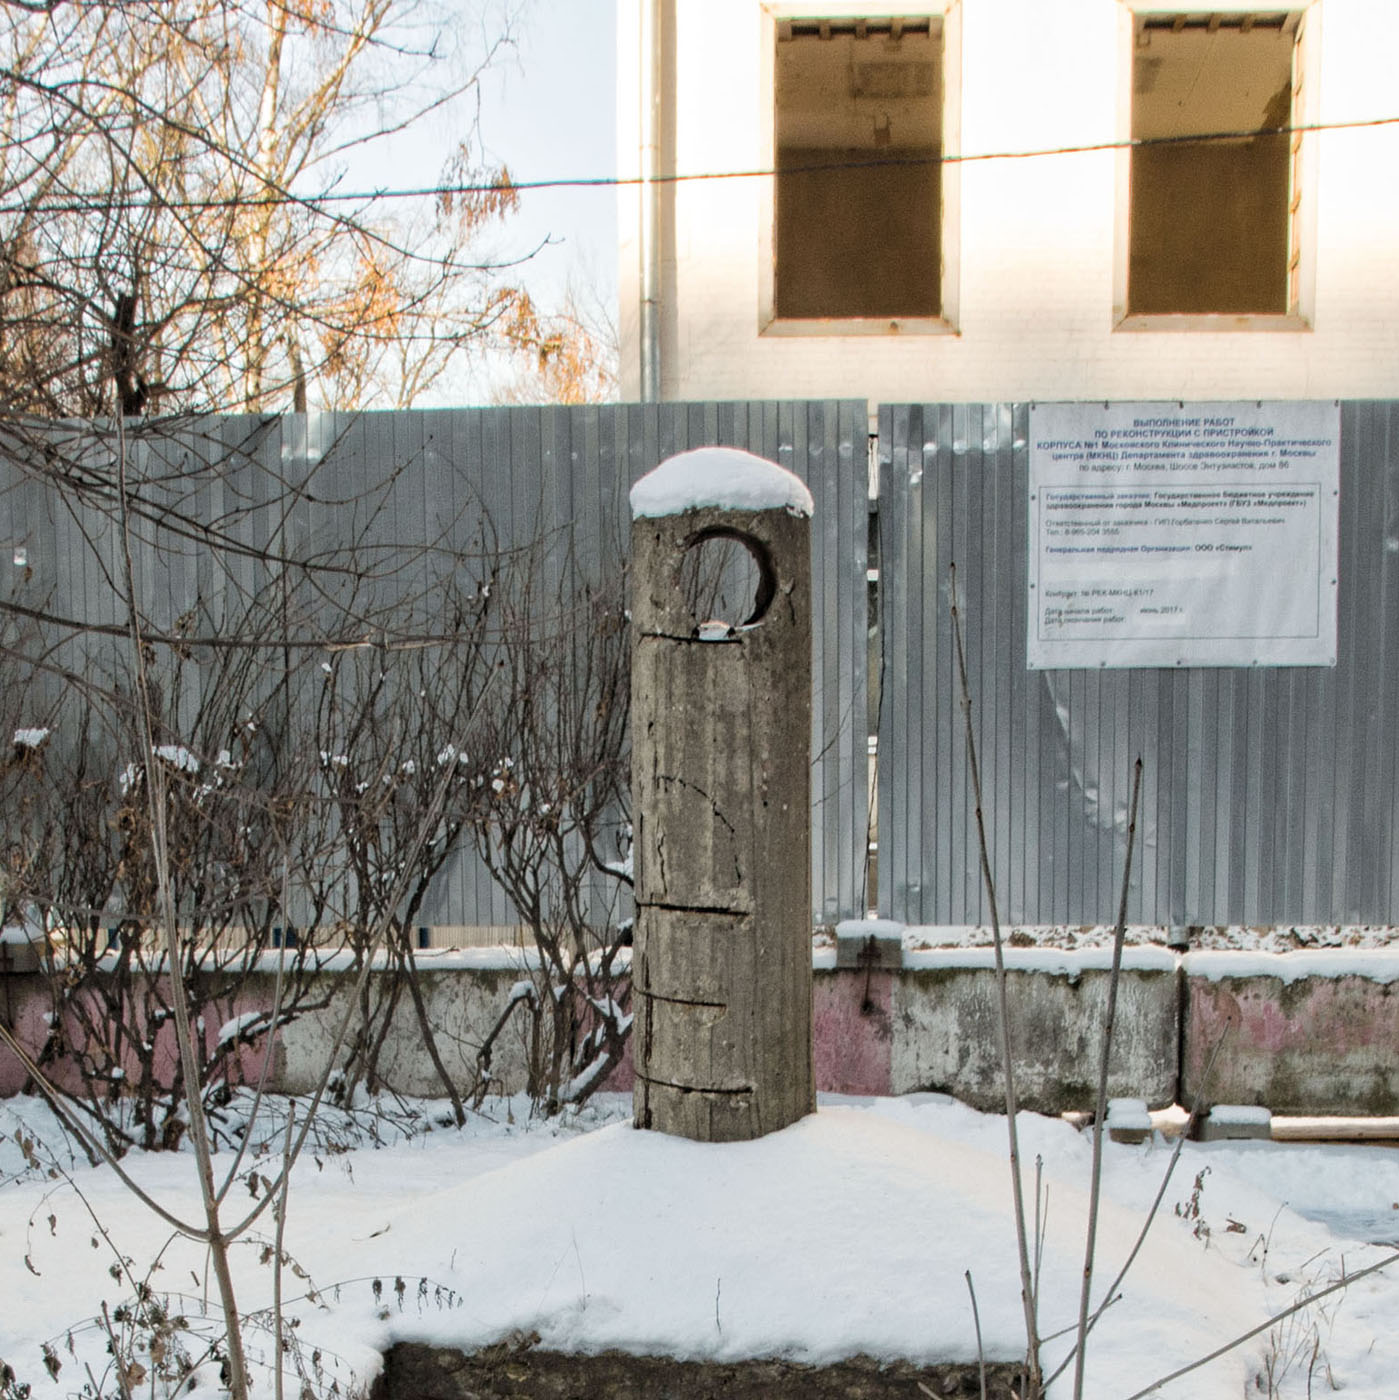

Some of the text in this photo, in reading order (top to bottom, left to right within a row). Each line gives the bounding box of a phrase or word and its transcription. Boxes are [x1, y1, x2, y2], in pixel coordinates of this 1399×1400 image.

[1133, 418, 1236, 428] ВЫПОЛНЕНИЕ РАБОТ
[1094, 430, 1108, 438] ПО
[1110, 429, 1192, 438] РЕКОНСТРУКЦИИ
[1203, 427, 1274, 437] ПРИСТРОЙКОЙ
[1037, 441, 1082, 450] КОРПУСА
[1101, 440, 1160, 449] Московского
[1162, 440, 1226, 448] Клинического
